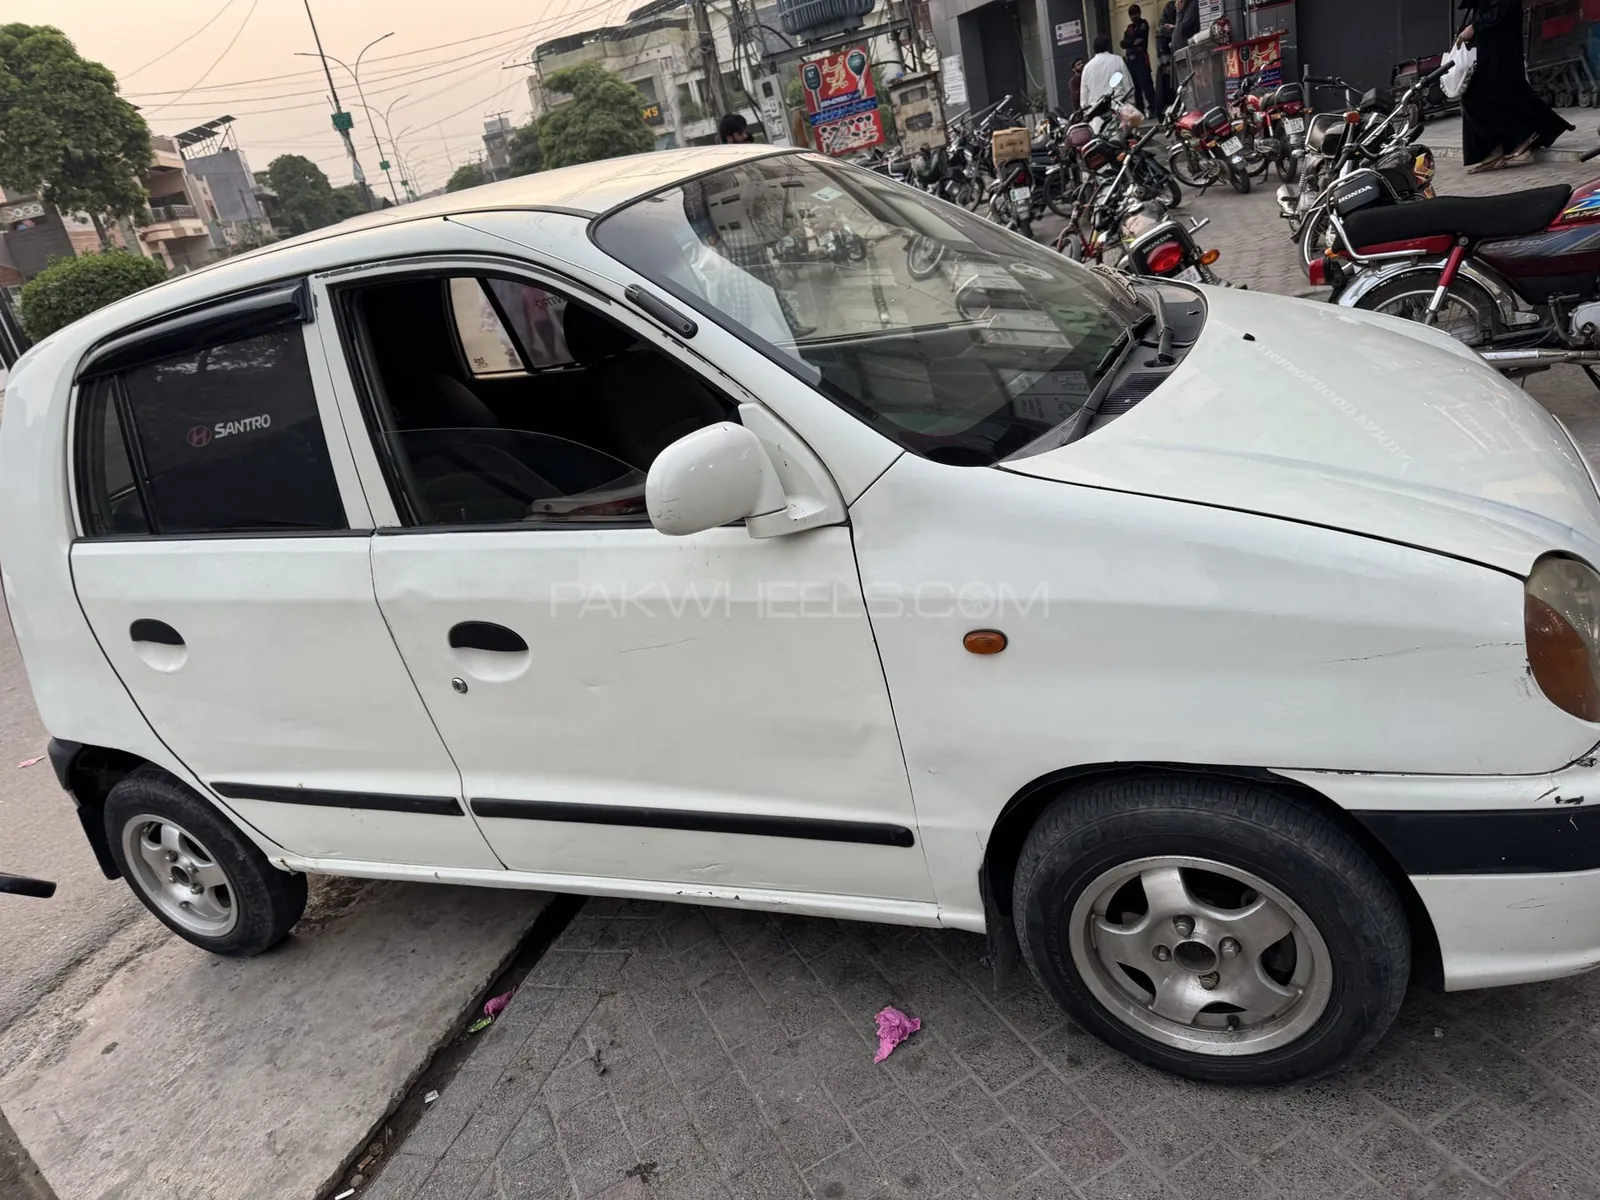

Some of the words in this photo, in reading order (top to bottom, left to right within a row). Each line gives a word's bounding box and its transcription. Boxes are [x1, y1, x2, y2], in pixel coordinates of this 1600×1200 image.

[1338, 185, 1373, 204] HONDA
[1142, 233, 1173, 254] HONDA
[214, 413, 271, 439] SANTRO
